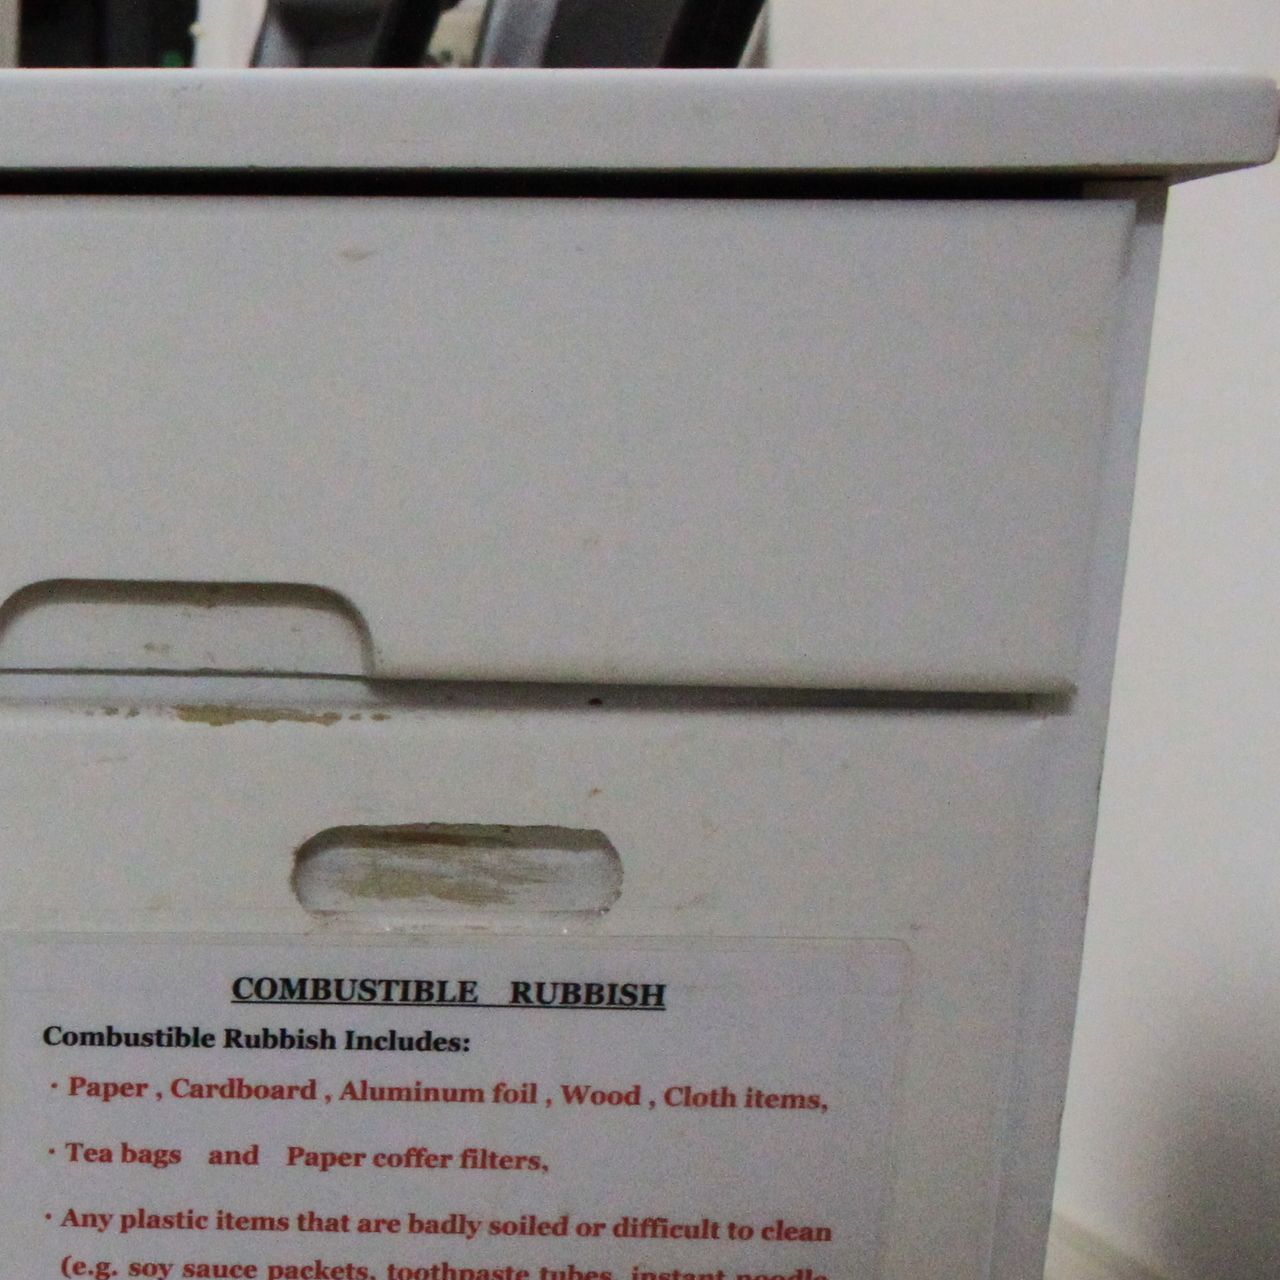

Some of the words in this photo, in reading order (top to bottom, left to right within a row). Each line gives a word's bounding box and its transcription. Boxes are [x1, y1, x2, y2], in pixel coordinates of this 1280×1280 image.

[231, 976, 479, 1003] COMBUSTIBLE
[510, 980, 667, 1007] RUBBISH
[41, 1024, 217, 1049] Combustible
[222, 1027, 337, 1051] Rubbish
[344, 1029, 471, 1053] Includes:
[64, 1141, 114, 1164] Tea
[120, 1141, 183, 1170] bags
[207, 1143, 260, 1167] and
[286, 1145, 368, 1173] Paper
[371, 1146, 454, 1170] coffer
[459, 1147, 549, 1173] filters,
[60, 1207, 114, 1234] Any
[119, 1206, 210, 1235] plastic
[215, 1208, 291, 1232] items
[295, 1209, 351, 1234] that
[355, 1217, 402, 1235] are
[407, 1212, 483, 1241] badly
[487, 1213, 570, 1238] soiled
[574, 1221, 607, 1238] or
[611, 1215, 721, 1241] difficult
[726, 1221, 755, 1241] to
[760, 1218, 833, 1243] clean
[181, 1262, 259, 1280] sauce
